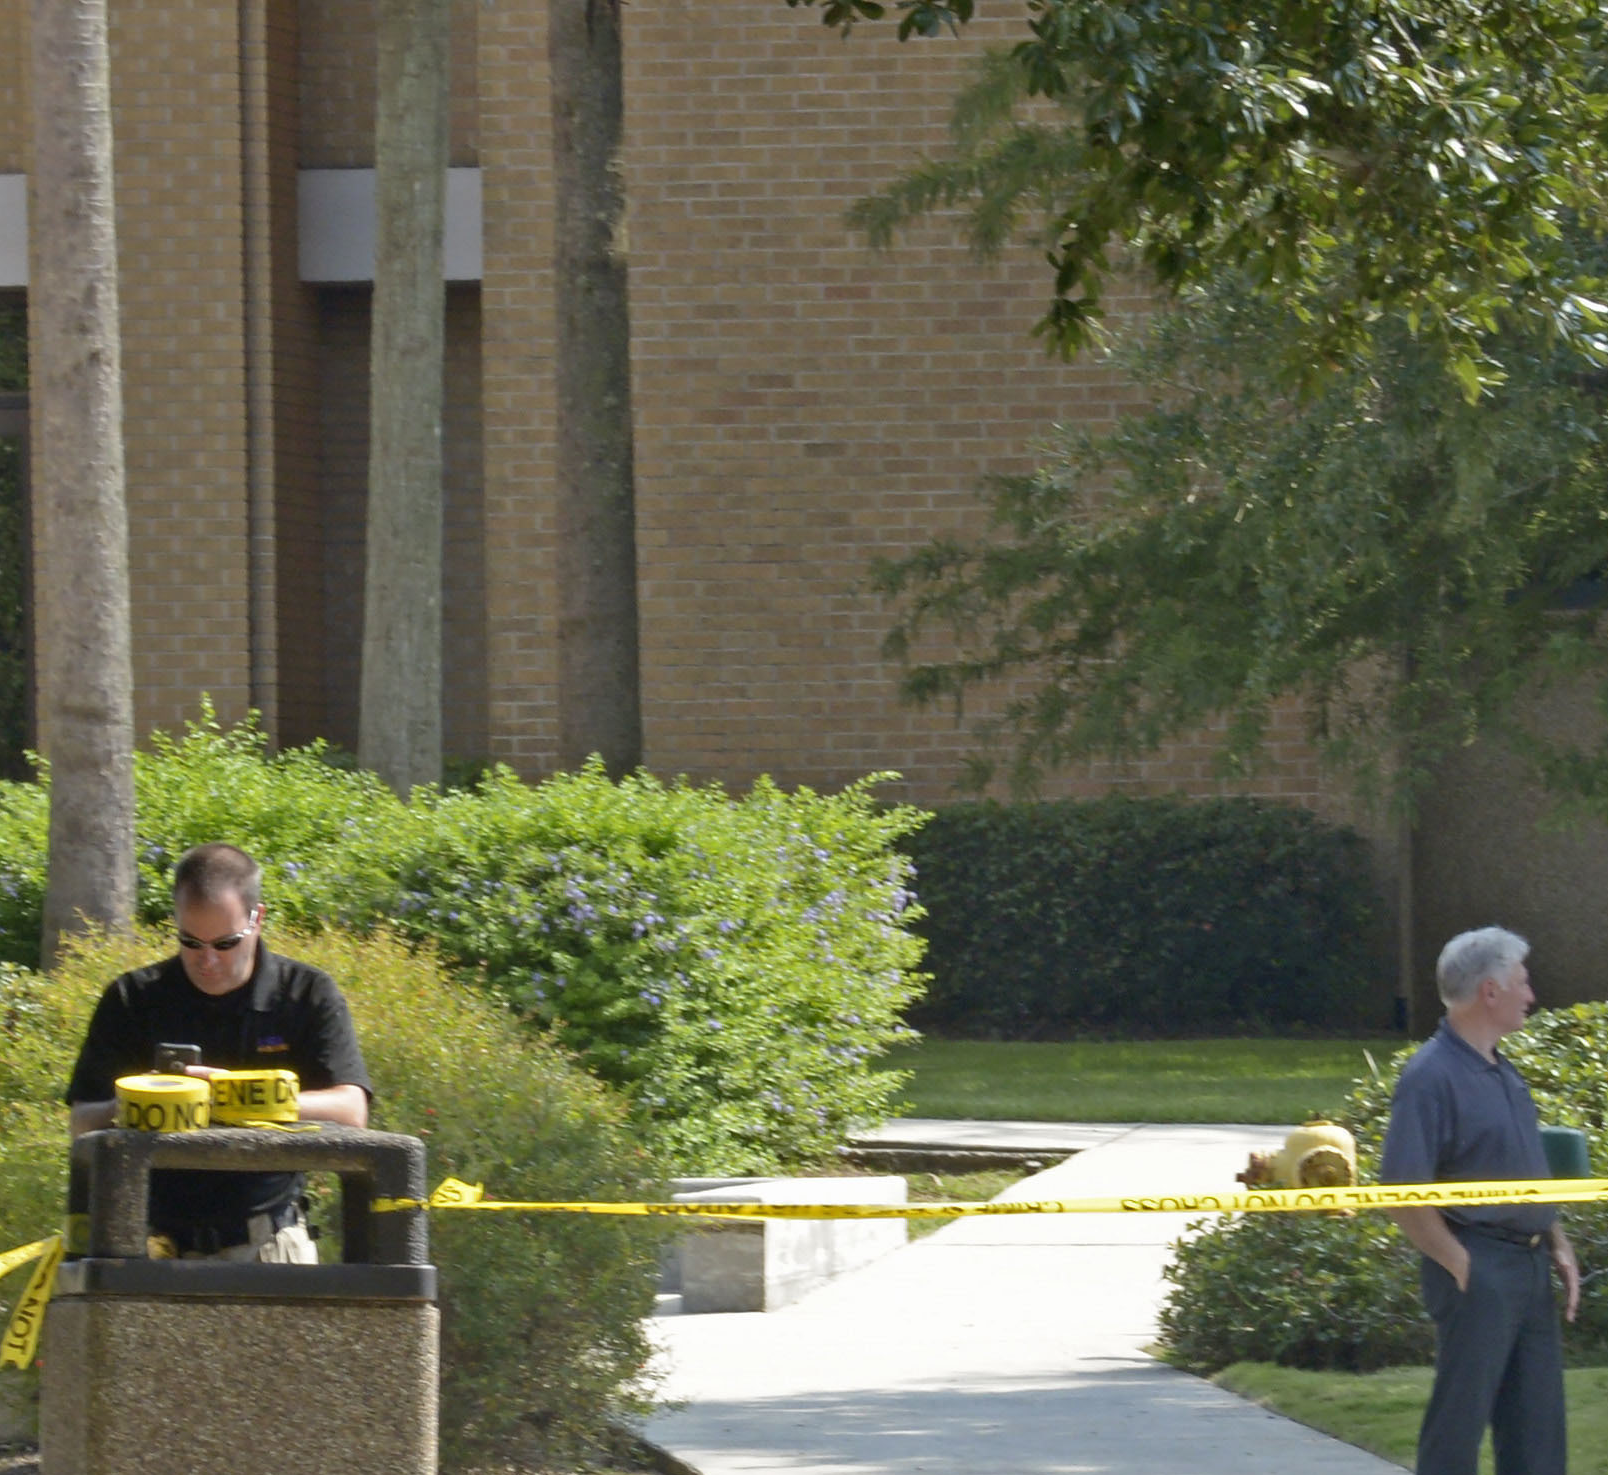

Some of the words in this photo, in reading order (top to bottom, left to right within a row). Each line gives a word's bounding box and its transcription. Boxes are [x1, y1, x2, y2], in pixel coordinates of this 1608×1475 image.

[214, 1078, 266, 1106] ENE
[127, 1102, 166, 1130] DO
[175, 1101, 210, 1130] NO
[7, 1297, 40, 1355] NOT
